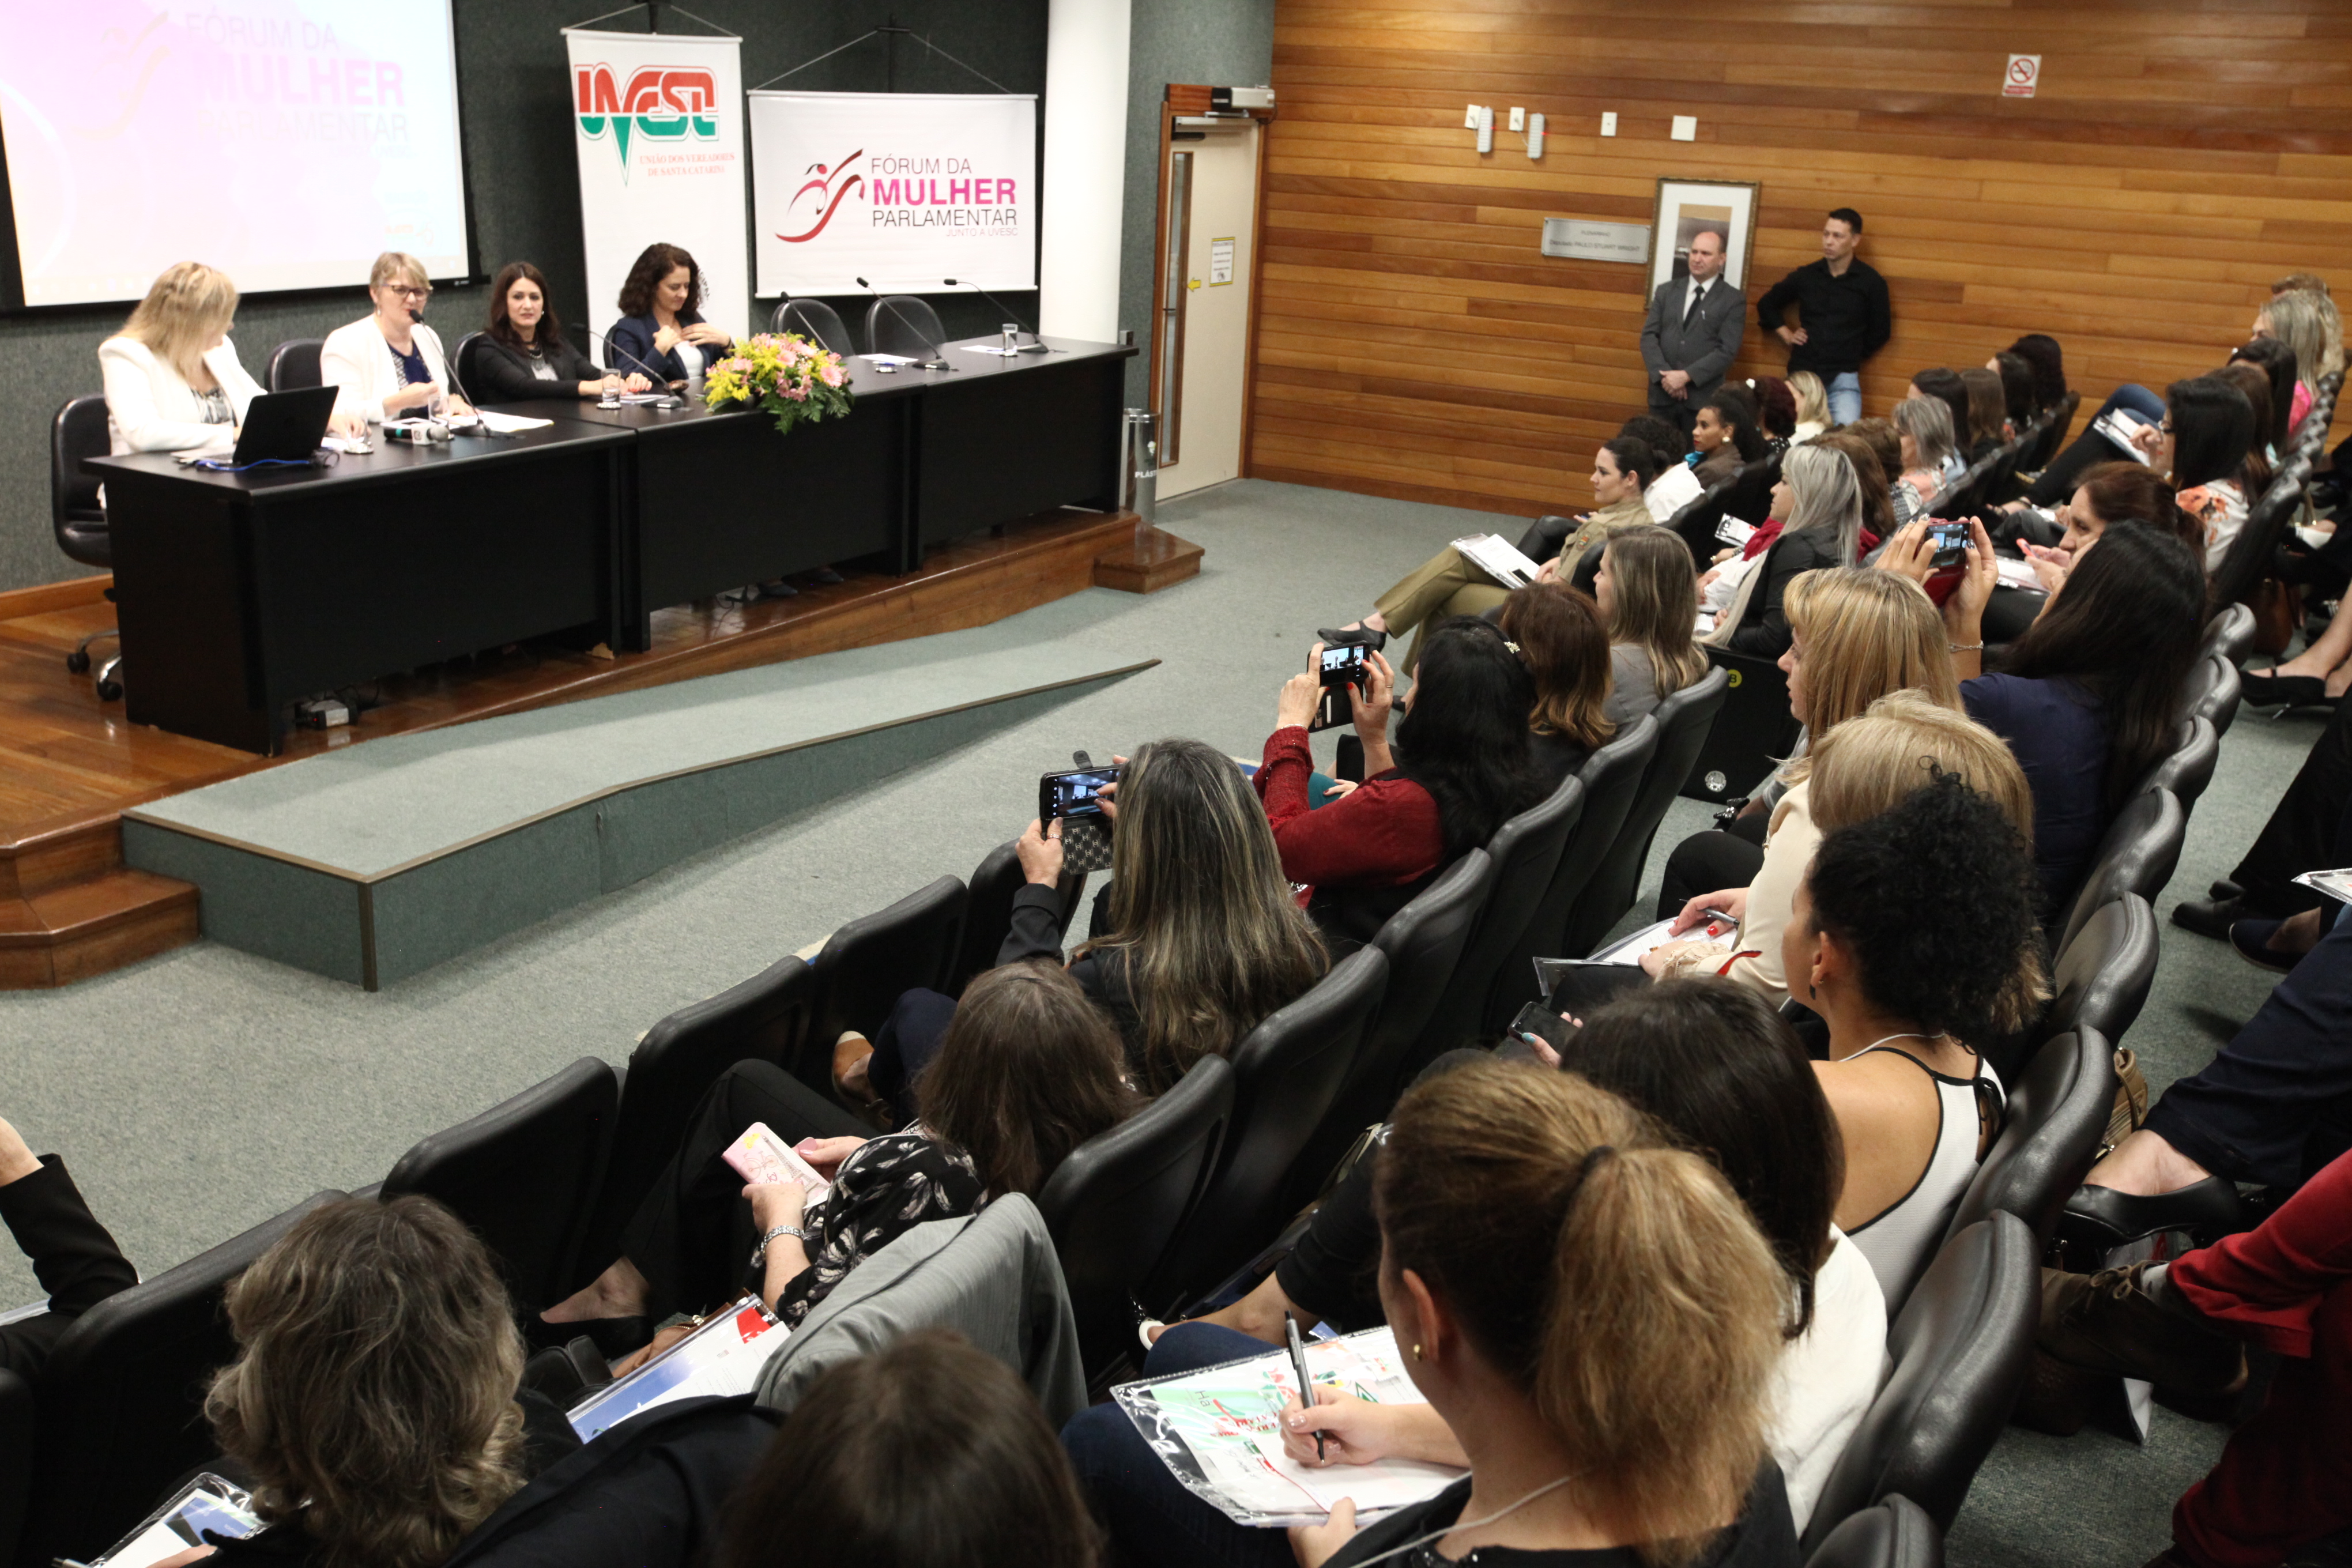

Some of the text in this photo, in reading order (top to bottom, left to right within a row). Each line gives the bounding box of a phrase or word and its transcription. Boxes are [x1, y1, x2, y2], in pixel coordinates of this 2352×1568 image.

[185, 5, 339, 51] FÓRUM DA
[191, 52, 405, 107] MULHER
[195, 109, 410, 142] PARLAMENTAR
[668, 154, 685, 163] DOS
[872, 153, 972, 175] FÓRUM DA
[647, 168, 658, 176] DE
[661, 167, 687, 176] SANTA
[873, 178, 1016, 206] MULHER
[873, 209, 1017, 227] PARLAMENTAR
[946, 227, 1018, 237] JUNTO A UVESC
